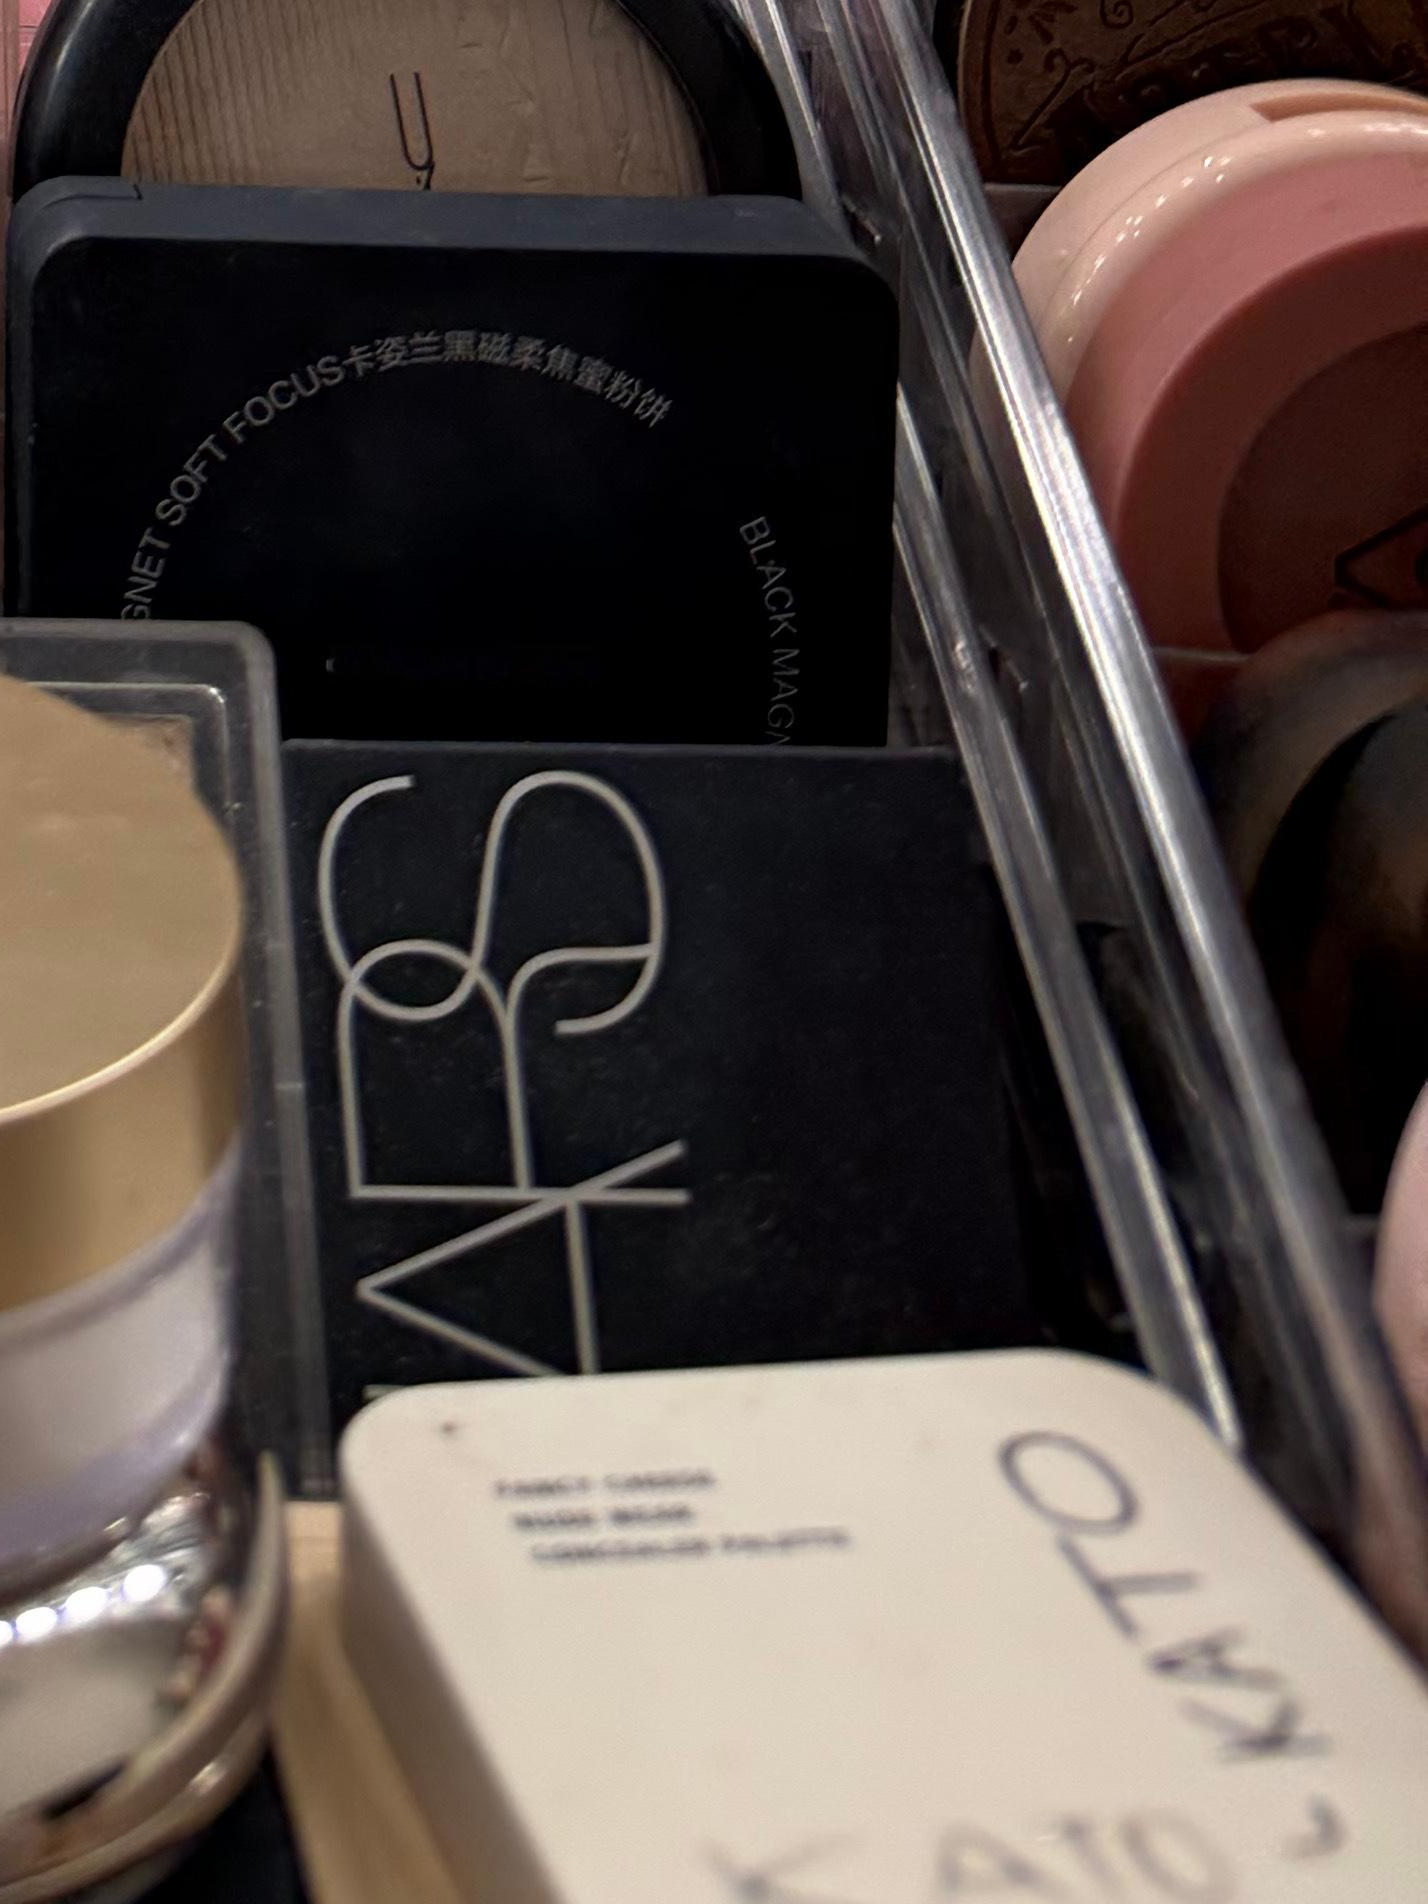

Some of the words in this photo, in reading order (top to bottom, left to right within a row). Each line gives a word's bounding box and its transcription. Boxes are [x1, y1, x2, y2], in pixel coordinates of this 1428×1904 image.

[121, 527, 170, 620] GNET
[156, 433, 228, 526] SOFT
[221, 355, 344, 445] FOCUS
[739, 516, 798, 639] BLACK
[318, 769, 691, 1404] ARS
[996, 1429, 1334, 1763] KATO
